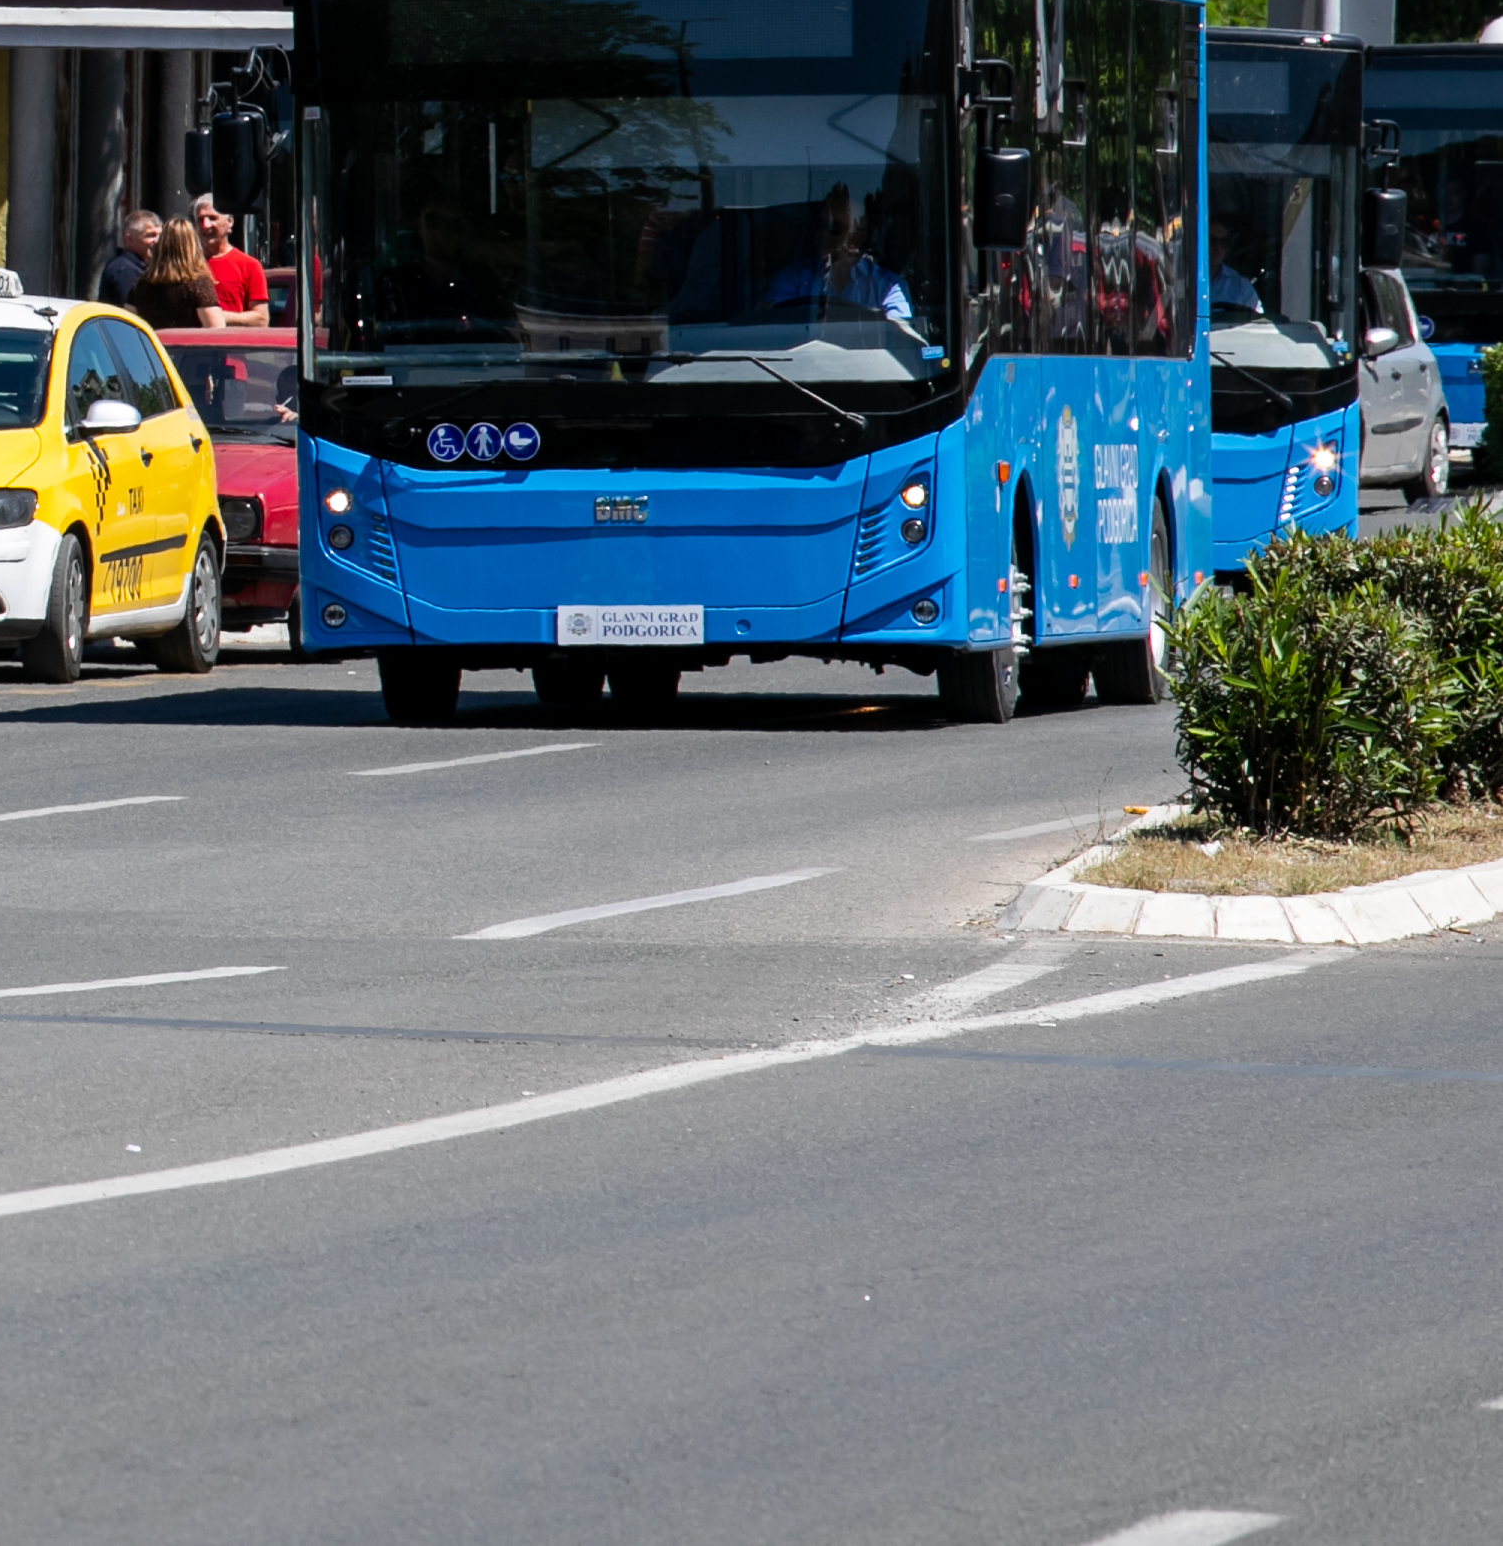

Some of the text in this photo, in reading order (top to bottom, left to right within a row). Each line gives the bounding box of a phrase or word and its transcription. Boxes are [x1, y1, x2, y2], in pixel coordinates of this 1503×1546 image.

[129, 485, 144, 516] TAXI
[595, 495, 649, 521] BMC
[602, 611, 699, 623] GLAVNI GRAD
[603, 625, 698, 637] PODGORICA
